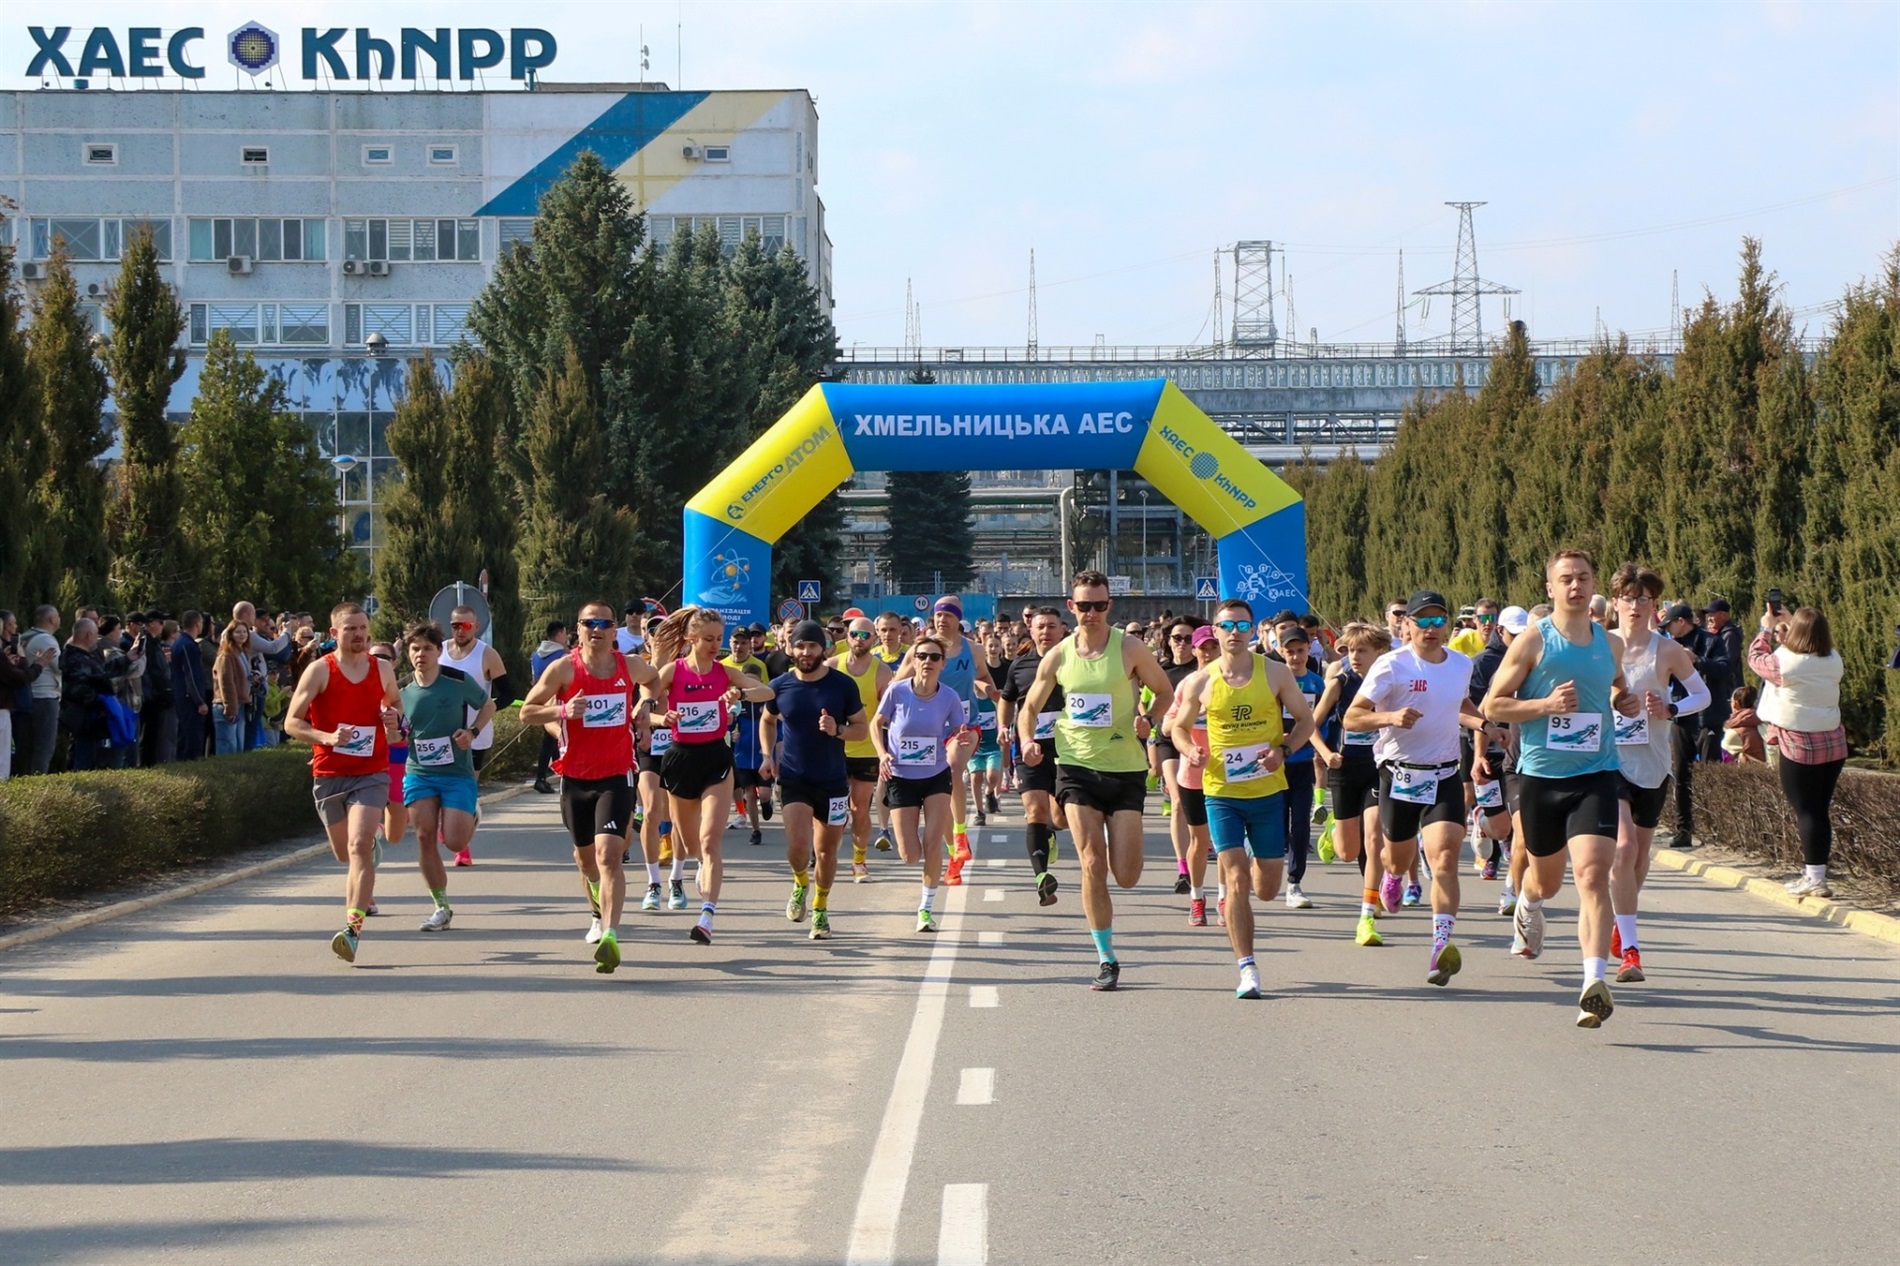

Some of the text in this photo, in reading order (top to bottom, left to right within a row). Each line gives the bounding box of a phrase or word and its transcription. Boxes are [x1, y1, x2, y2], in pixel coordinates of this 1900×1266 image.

[25, 26, 206, 79] ХАЕС
[301, 27, 558, 81] KhNPP
[854, 411, 1133, 439] ХМЕЛЬНИЦЬКА АЕС
[1159, 425, 1195, 458] ХАЕС
[1213, 473, 1257, 509] KhNPP
[586, 700, 608, 710] 401
[1071, 698, 1085, 708] 20
[679, 706, 699, 716] 216
[1551, 716, 1572, 730] 93
[416, 743, 436, 752] 256
[900, 740, 919, 750] 215
[1225, 752, 1244, 765] 24
